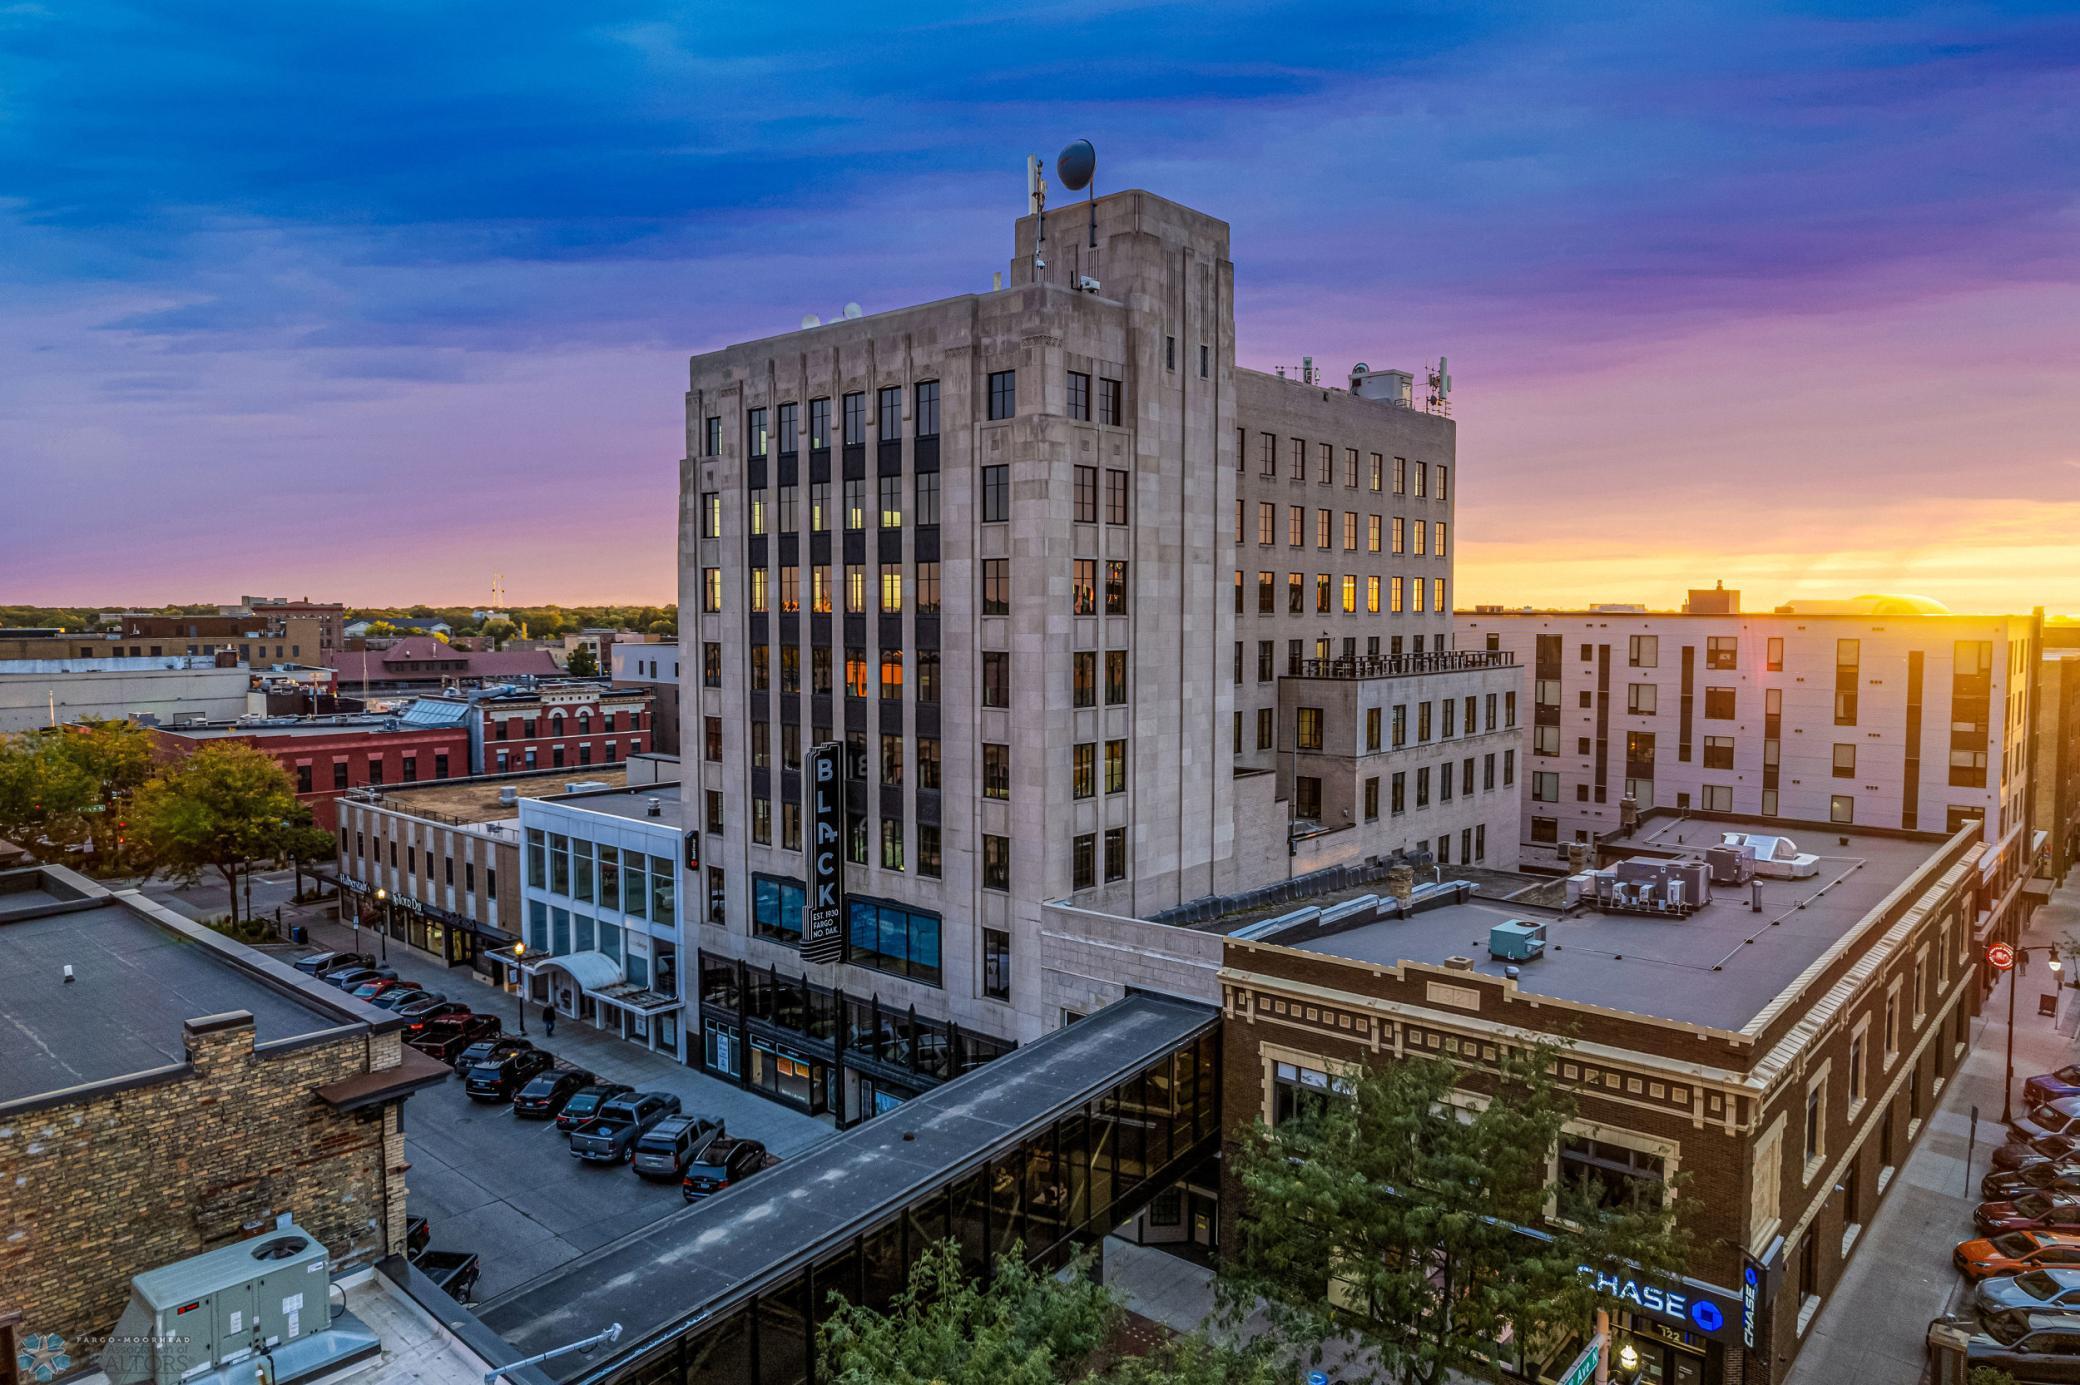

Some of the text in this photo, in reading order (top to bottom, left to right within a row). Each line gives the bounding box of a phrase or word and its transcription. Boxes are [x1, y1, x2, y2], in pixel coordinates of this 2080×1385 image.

[818, 758, 838, 907] BLACK
[813, 909, 839, 920] EST. 1930
[813, 919, 834, 930] FARGO
[1577, 1264, 1686, 1320] CHASE
[1744, 1283, 1756, 1349] CHASE
